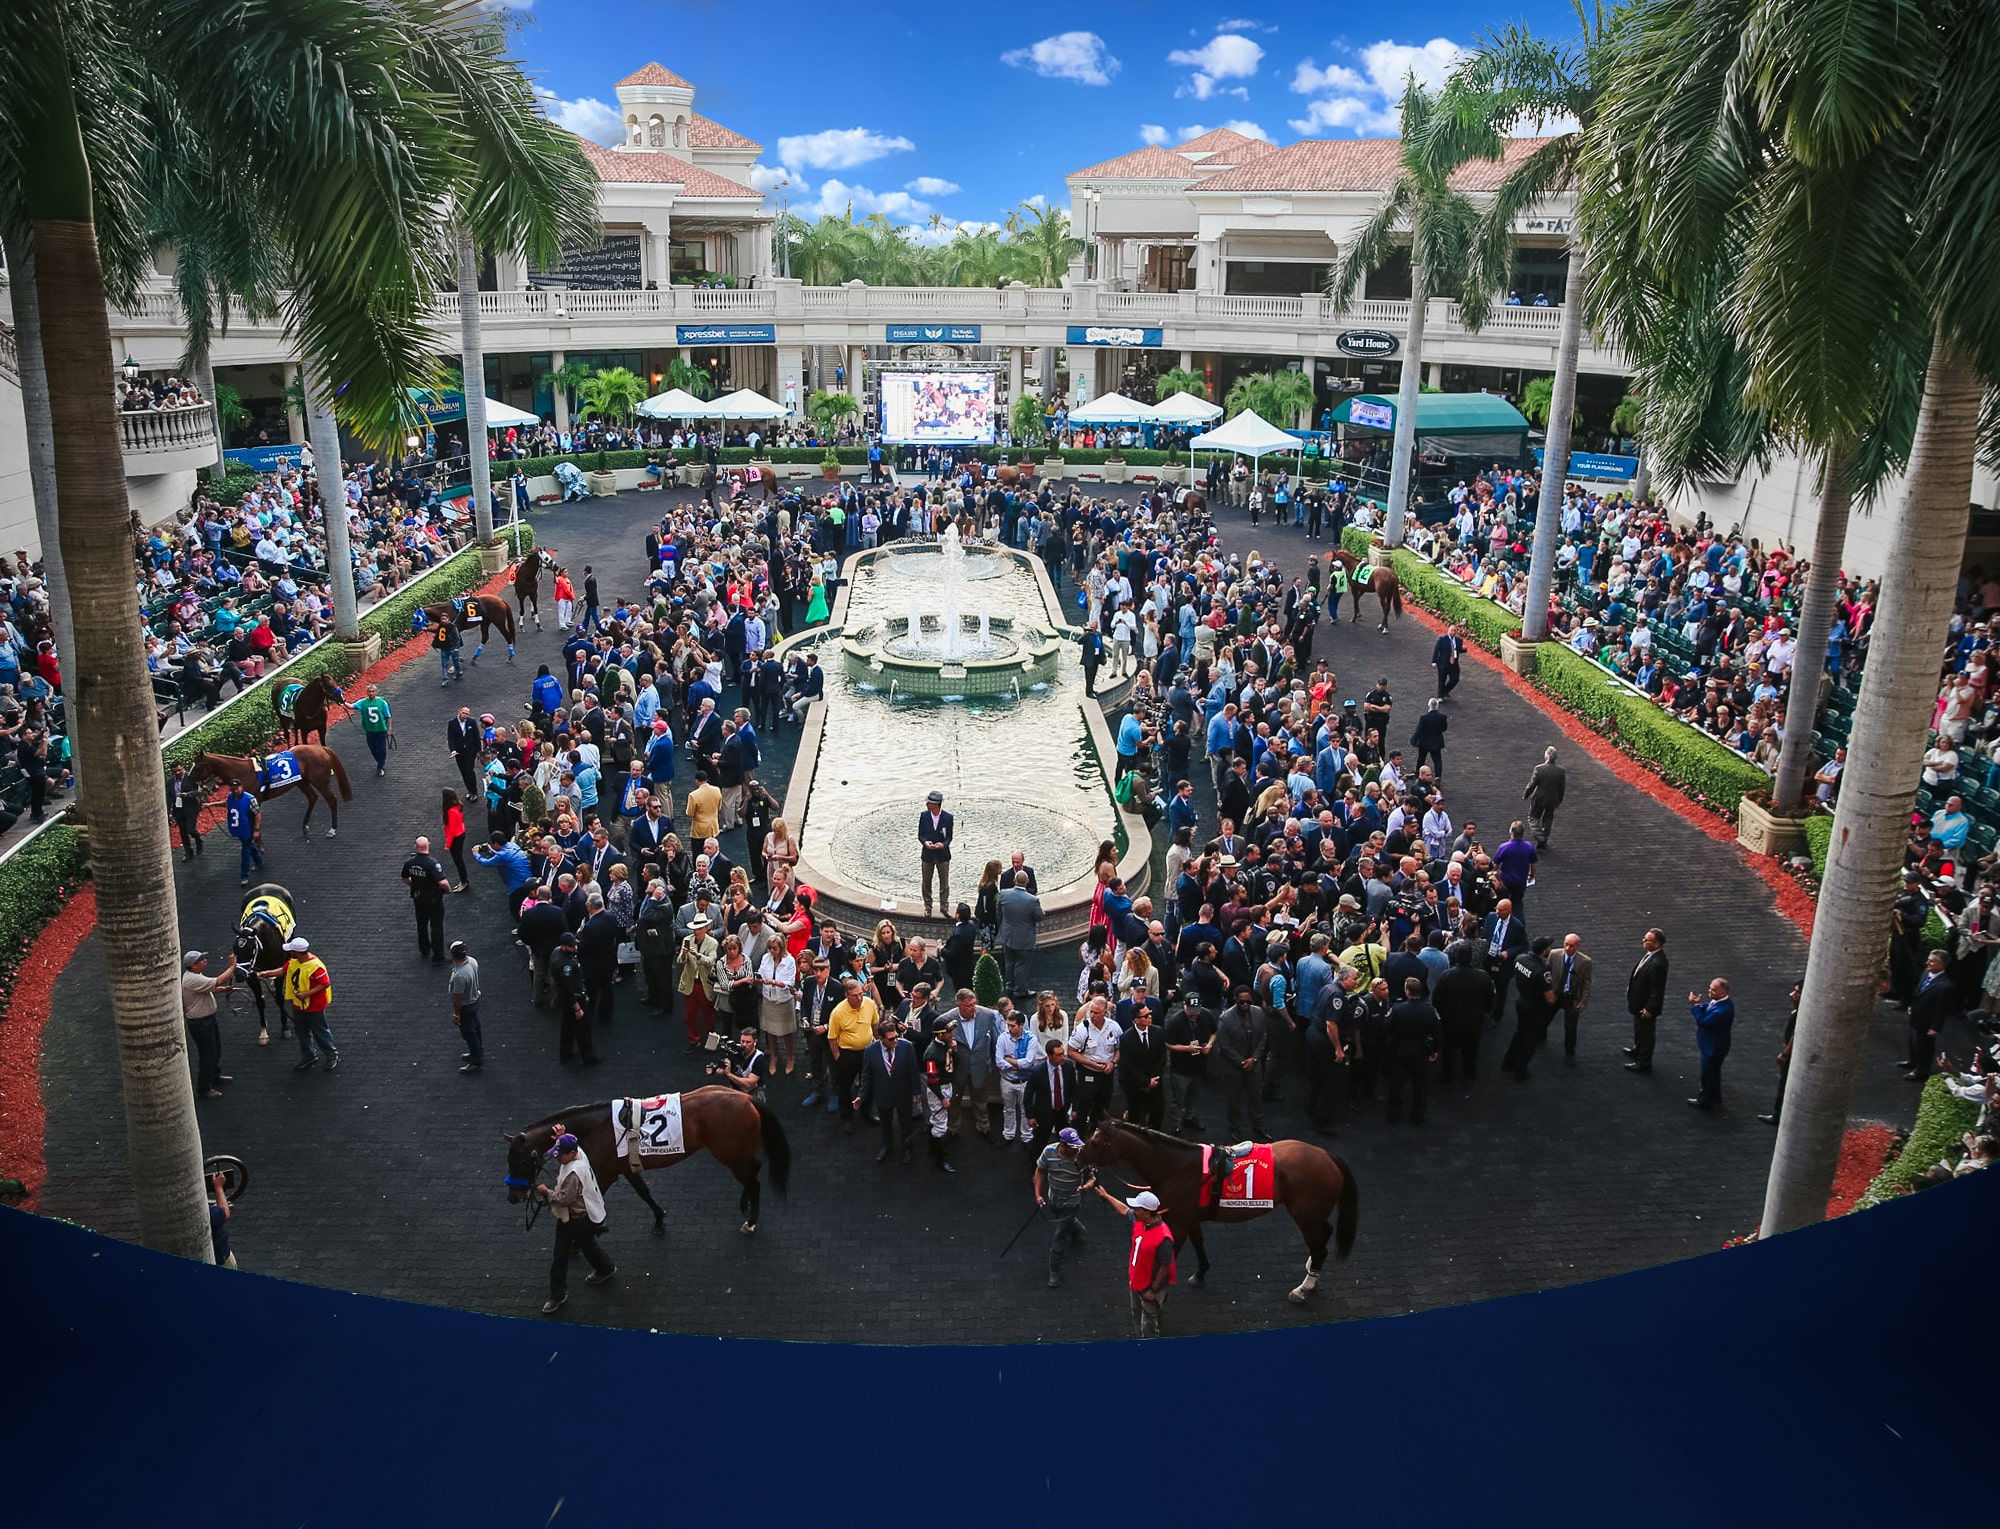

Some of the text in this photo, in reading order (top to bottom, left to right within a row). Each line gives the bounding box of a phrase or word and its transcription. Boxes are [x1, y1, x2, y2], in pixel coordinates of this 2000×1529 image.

[683, 330, 727, 339] xpressbet
[1347, 337, 1390, 349] Yard House
[467, 603, 477, 616] 6
[438, 627, 447, 641] 6
[281, 694, 289, 710] 5
[368, 706, 379, 723] 5
[278, 760, 292, 779] 3
[230, 808, 239, 826] 3
[1515, 961, 1532, 978] POLICE
[929, 1061, 933, 1073] 1
[649, 1114, 669, 1147] 2
[1244, 1163, 1255, 1199] 1
[1131, 1235, 1143, 1267] 1
